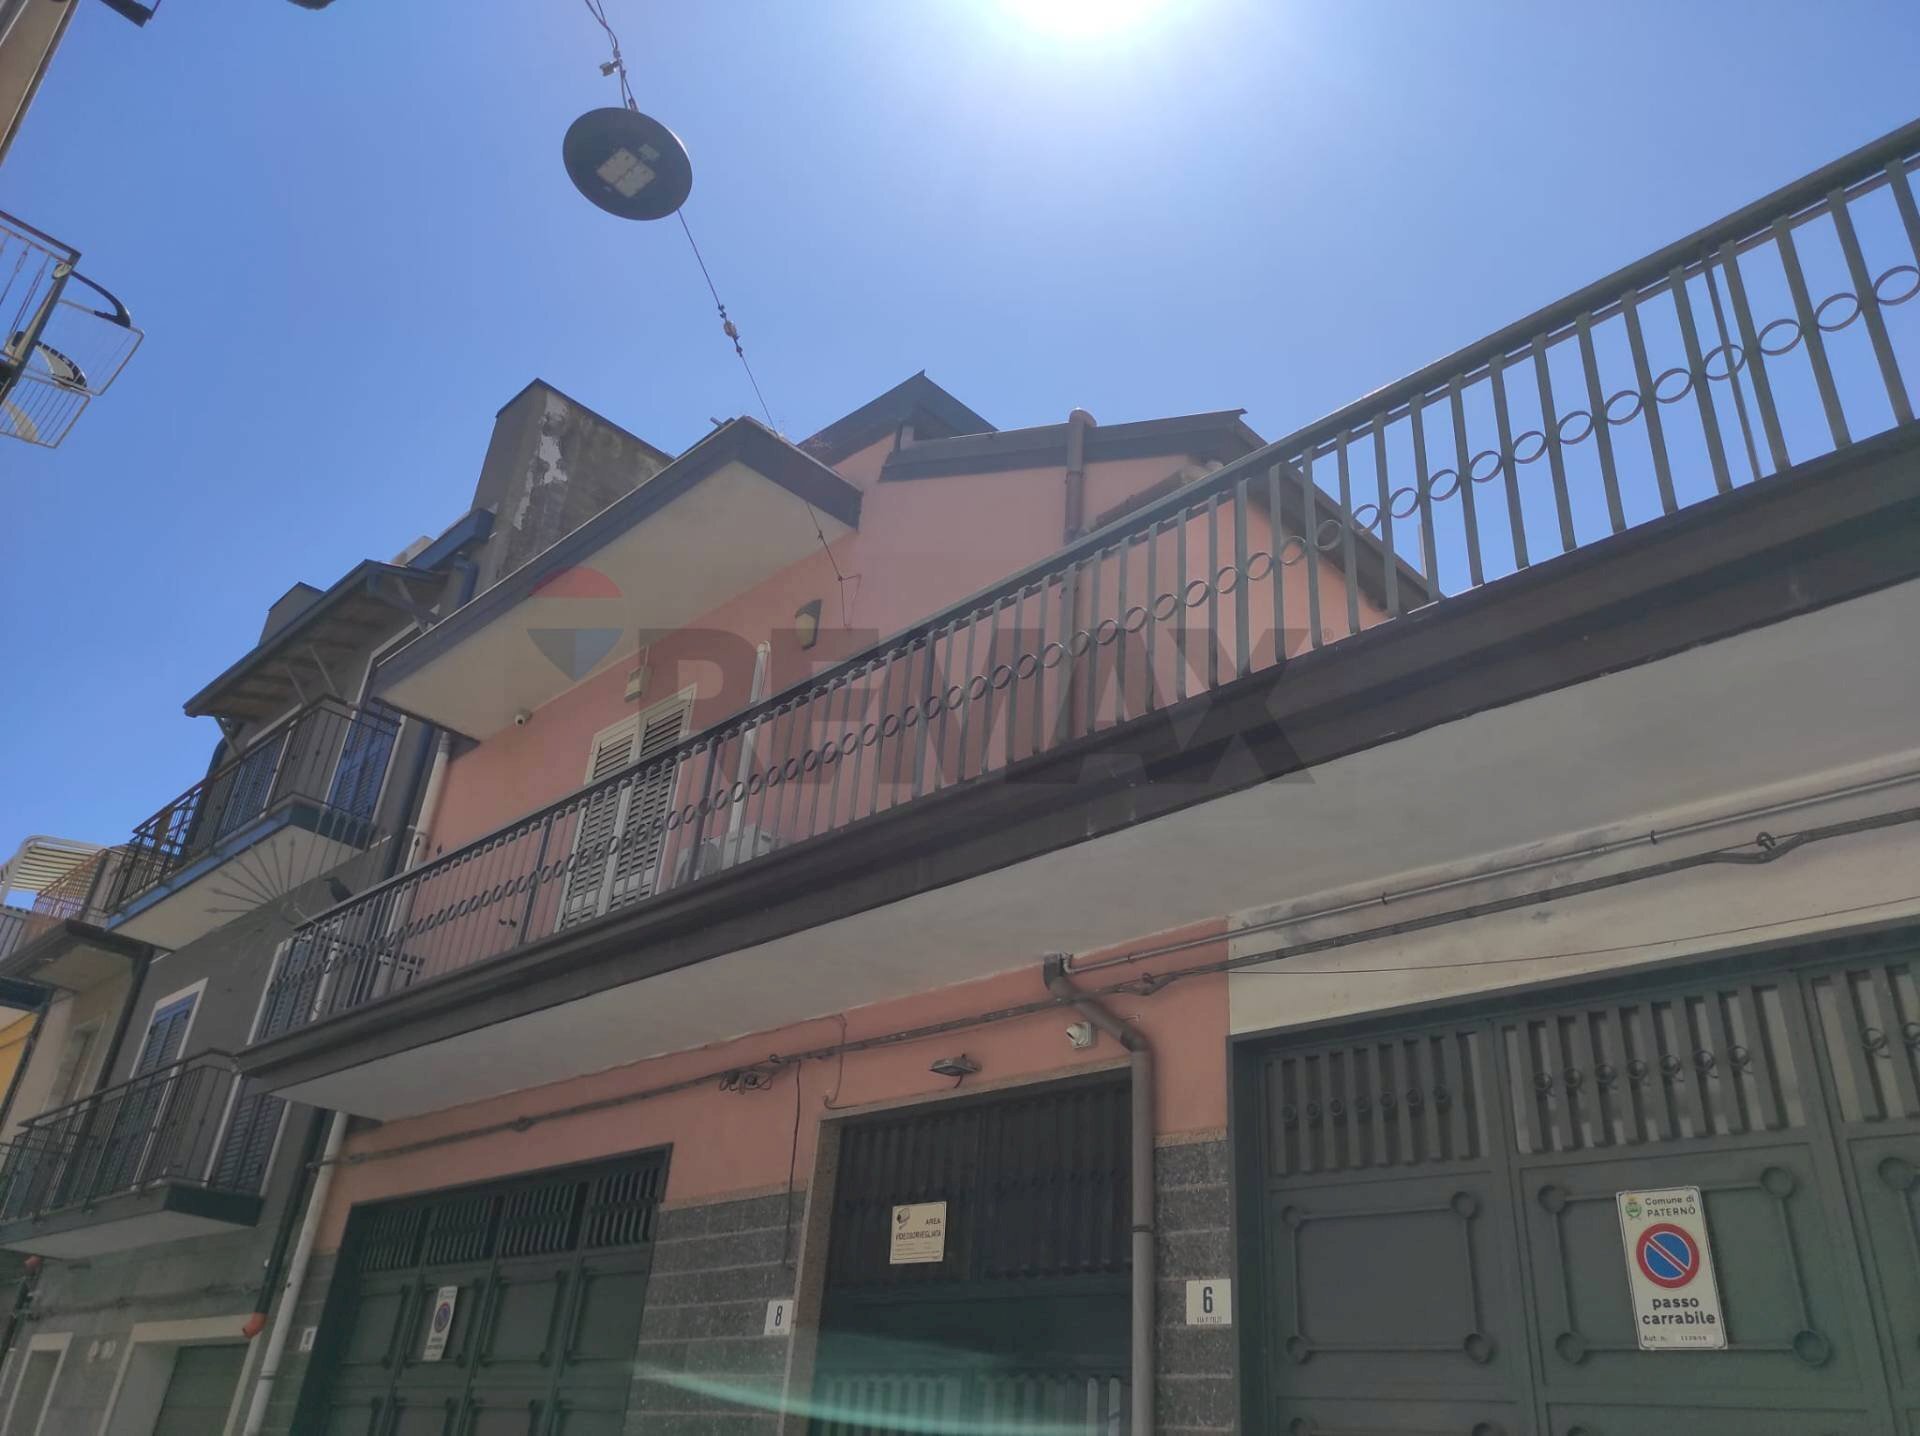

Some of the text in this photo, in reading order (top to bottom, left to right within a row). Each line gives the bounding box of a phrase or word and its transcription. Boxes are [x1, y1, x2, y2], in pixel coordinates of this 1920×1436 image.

[1645, 1195, 1695, 1206] Comune di
[1203, 1286, 1213, 1314] 6
[1652, 1297, 1699, 1311] passo
[775, 1304, 783, 1327] 8
[1642, 1311, 1716, 1325] carrabile
